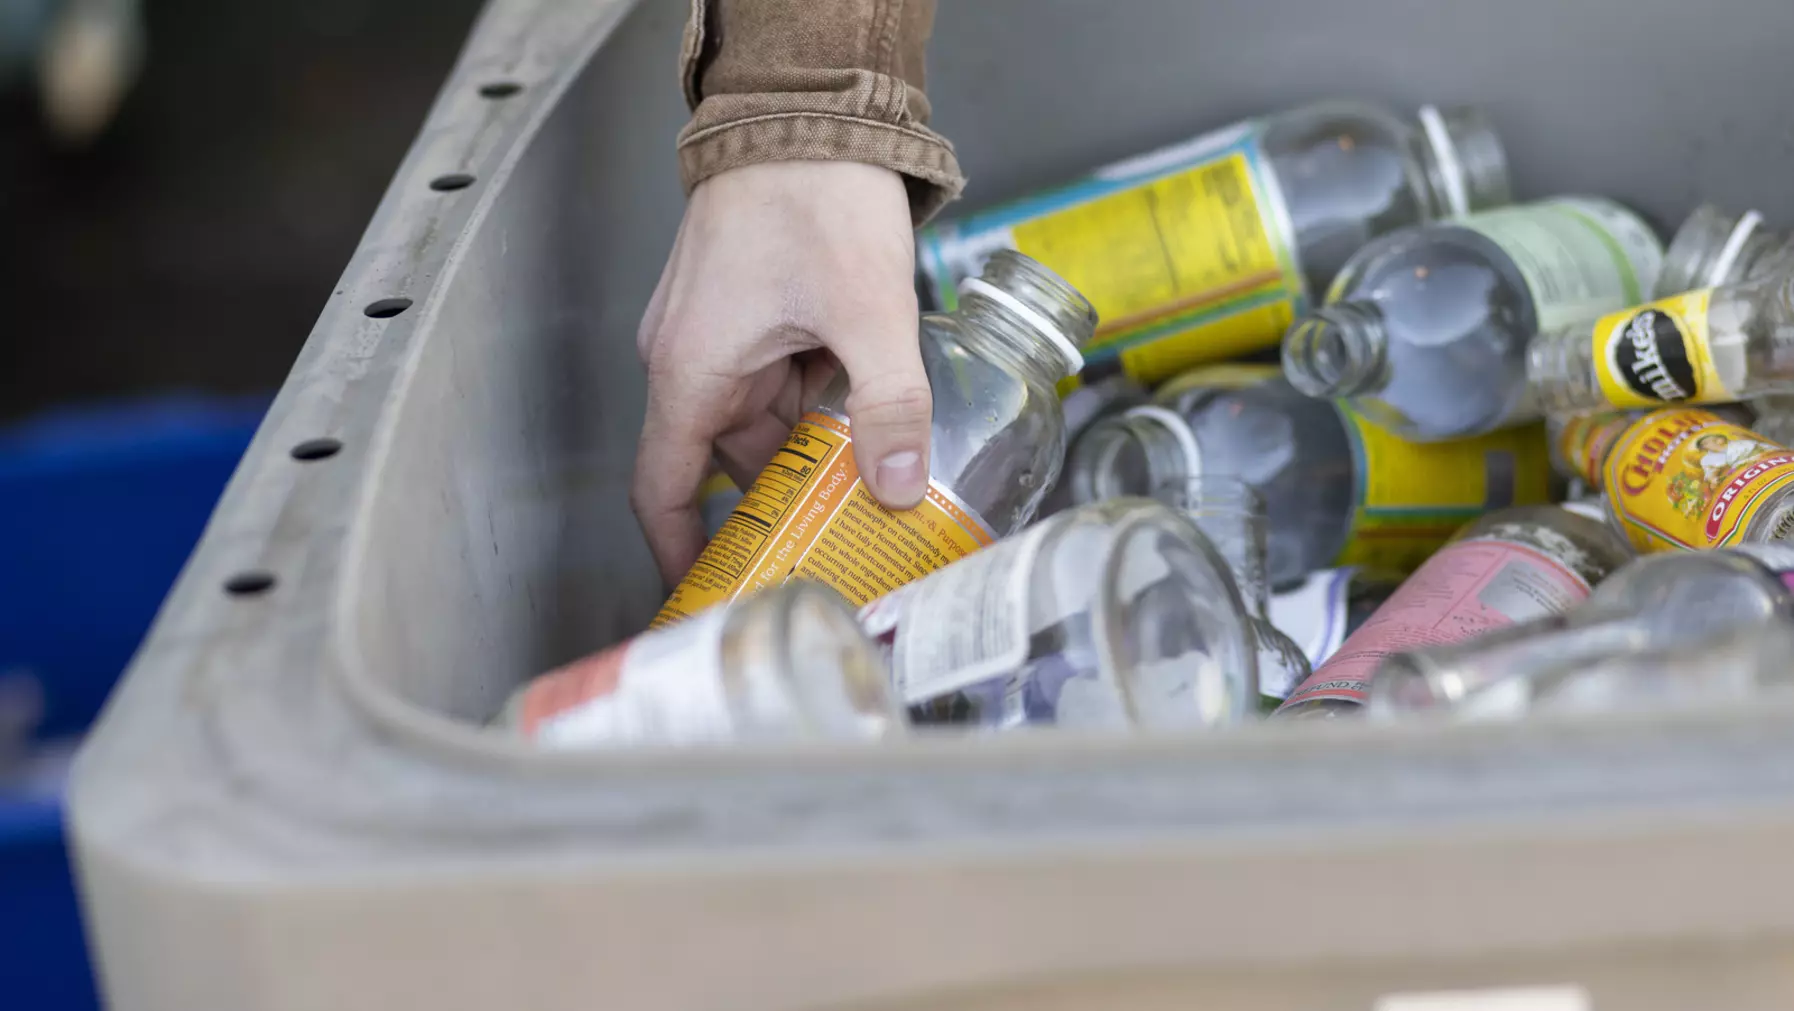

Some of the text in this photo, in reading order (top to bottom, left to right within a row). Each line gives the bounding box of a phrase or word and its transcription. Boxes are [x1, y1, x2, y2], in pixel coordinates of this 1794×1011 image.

[1711, 455, 1794, 523] ORIGIN
[759, 560, 779, 581] for
[774, 538, 795, 562] the
[789, 499, 824, 540] Living
[841, 507, 862, 525] finest
[861, 522, 876, 535] raw
[847, 498, 888, 529] philosophy
[886, 526, 898, 536] on
[896, 533, 923, 557] crafting
[921, 552, 933, 565] the
[895, 517, 917, 536] words
[916, 533, 941, 556] embody
[813, 546, 849, 574] occurring
[820, 536, 838, 551] only
[837, 548, 860, 567] whole
[827, 526, 856, 549] without
[854, 546, 887, 573] shortcuts
[885, 570, 895, 579] or
[838, 519, 857, 535] have
[855, 531, 873, 547] fully
[871, 543, 906, 573] fermented
[937, 527, 968, 558] Purpos
[806, 555, 840, 582] culturing
